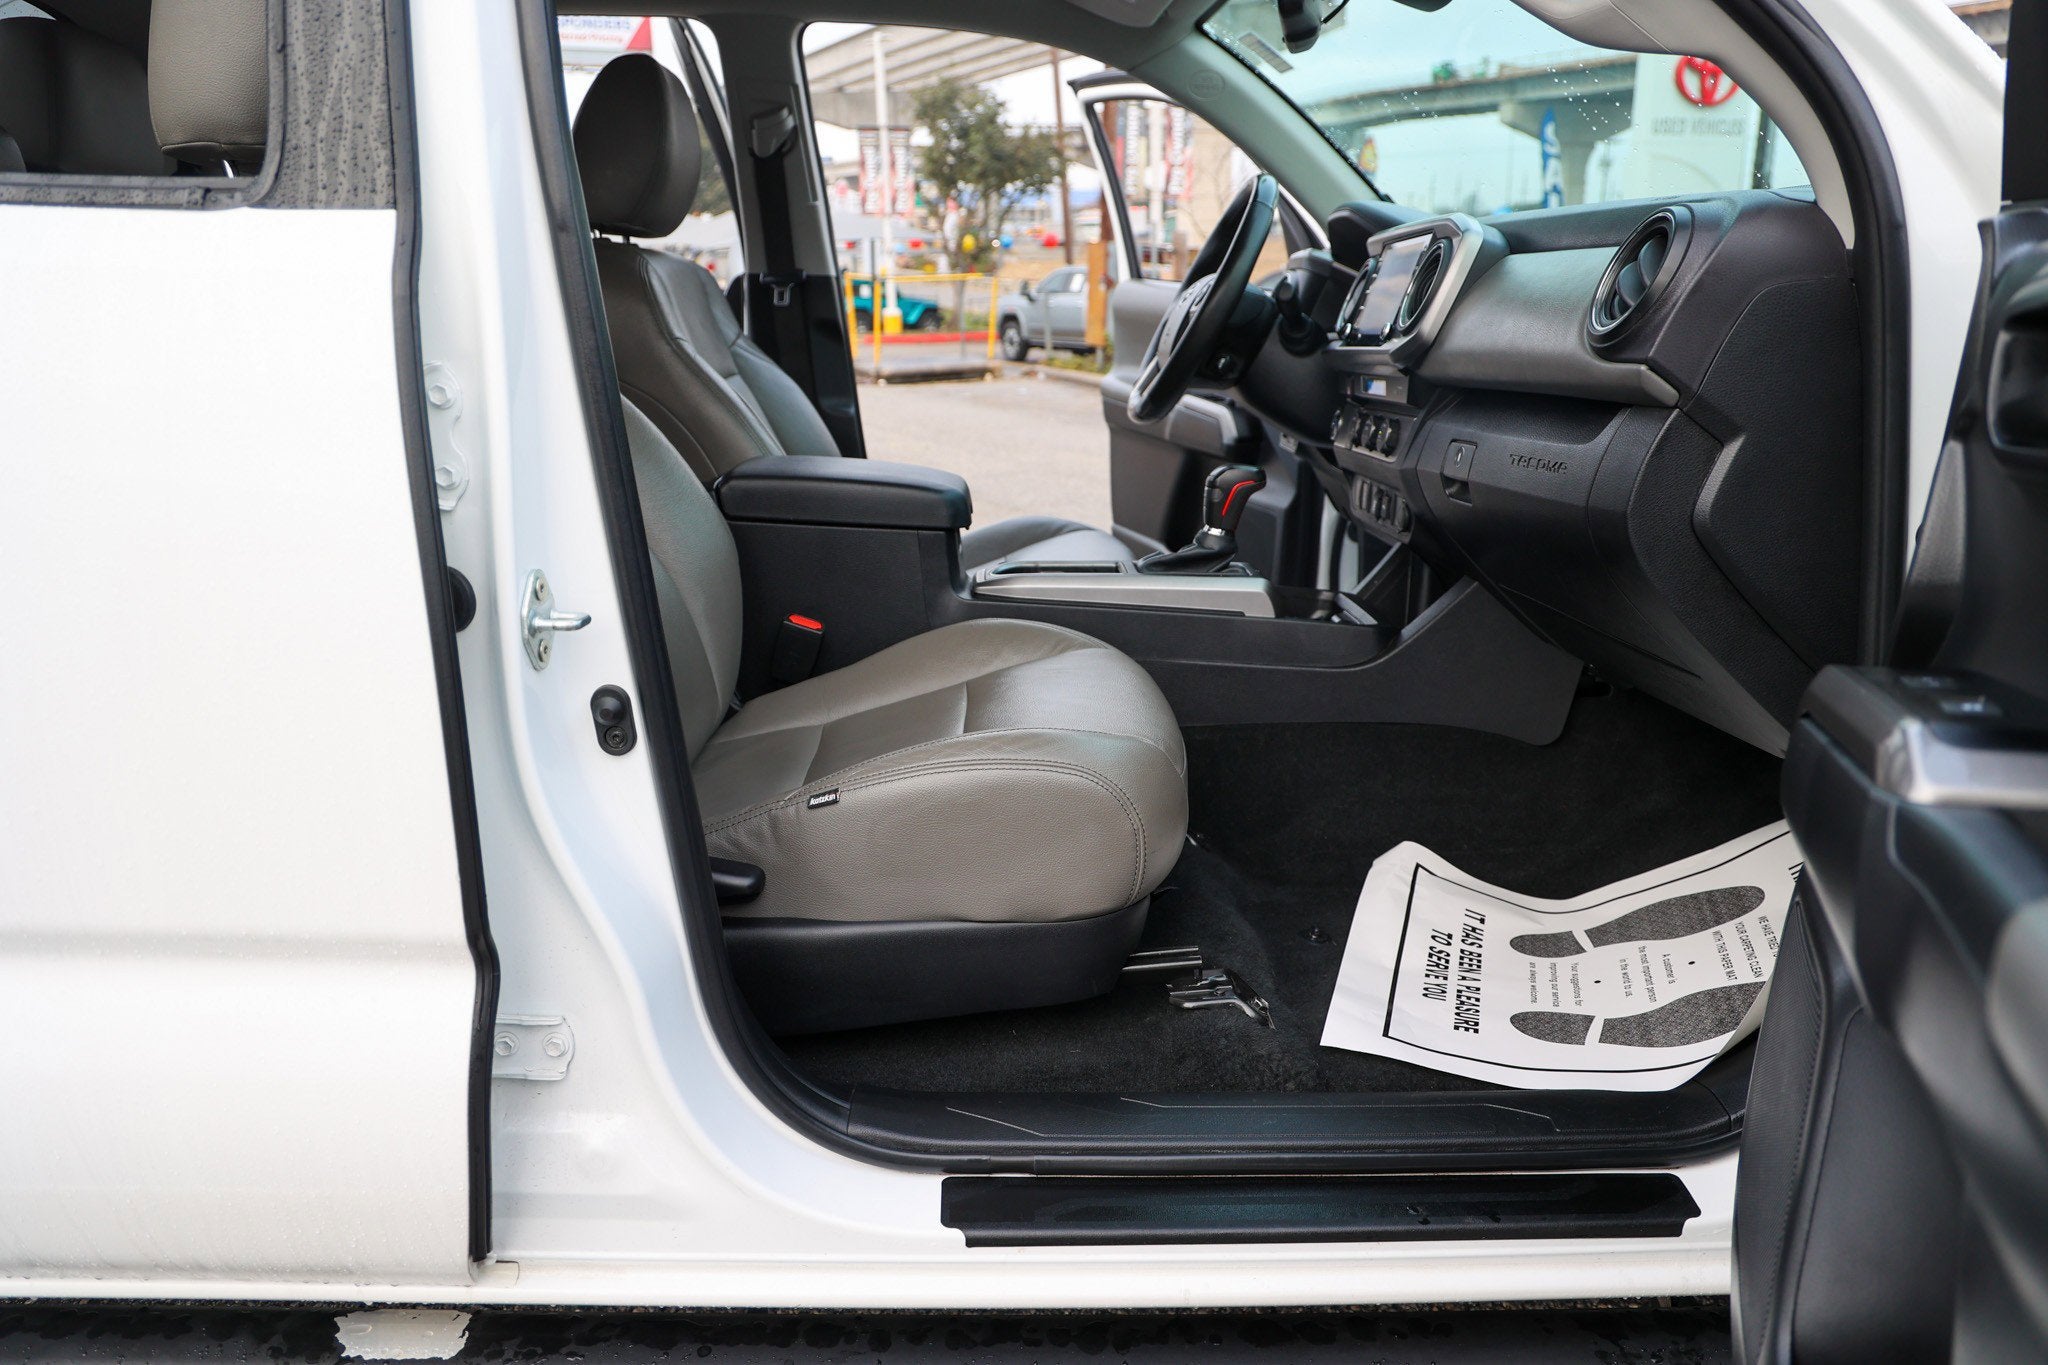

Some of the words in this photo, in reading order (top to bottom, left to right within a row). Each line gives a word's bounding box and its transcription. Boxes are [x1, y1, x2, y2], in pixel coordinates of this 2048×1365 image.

[1509, 453, 1568, 474] TACOMA
[1464, 908, 1486, 925] IT
[1758, 915, 1769, 924] WE
[1460, 922, 1485, 948] HAS
[1712, 930, 1723, 943] WITH
[1735, 921, 1747, 935] YOUR
[1761, 923, 1774, 937] HAVE
[1430, 928, 1453, 946] TO
[1716, 942, 1727, 953] THIS
[1739, 934, 1757, 961] CARPETING
[1424, 945, 1451, 981] SERVE
[1458, 948, 1483, 975] BEEN
[1620, 963, 1629, 971] the
[1640, 953, 1650, 965] most
[1720, 953, 1733, 970] PAPER
[1549, 962, 1559, 982] improving
[1641, 965, 1654, 986] important
[1663, 958, 1675, 978] customer
[1725, 969, 1738, 981] MAT
[1750, 960, 1764, 979] CLEAN
[1457, 974, 1482, 982] A
[1570, 973, 1581, 999] suggestions
[1622, 972, 1632, 984] world
[1422, 981, 1448, 1001] YOU
[1551, 983, 1559, 991] our
[1645, 986, 1657, 1003] person
[1552, 992, 1562, 1007] service
[1453, 983, 1481, 1034] PLEASURE
